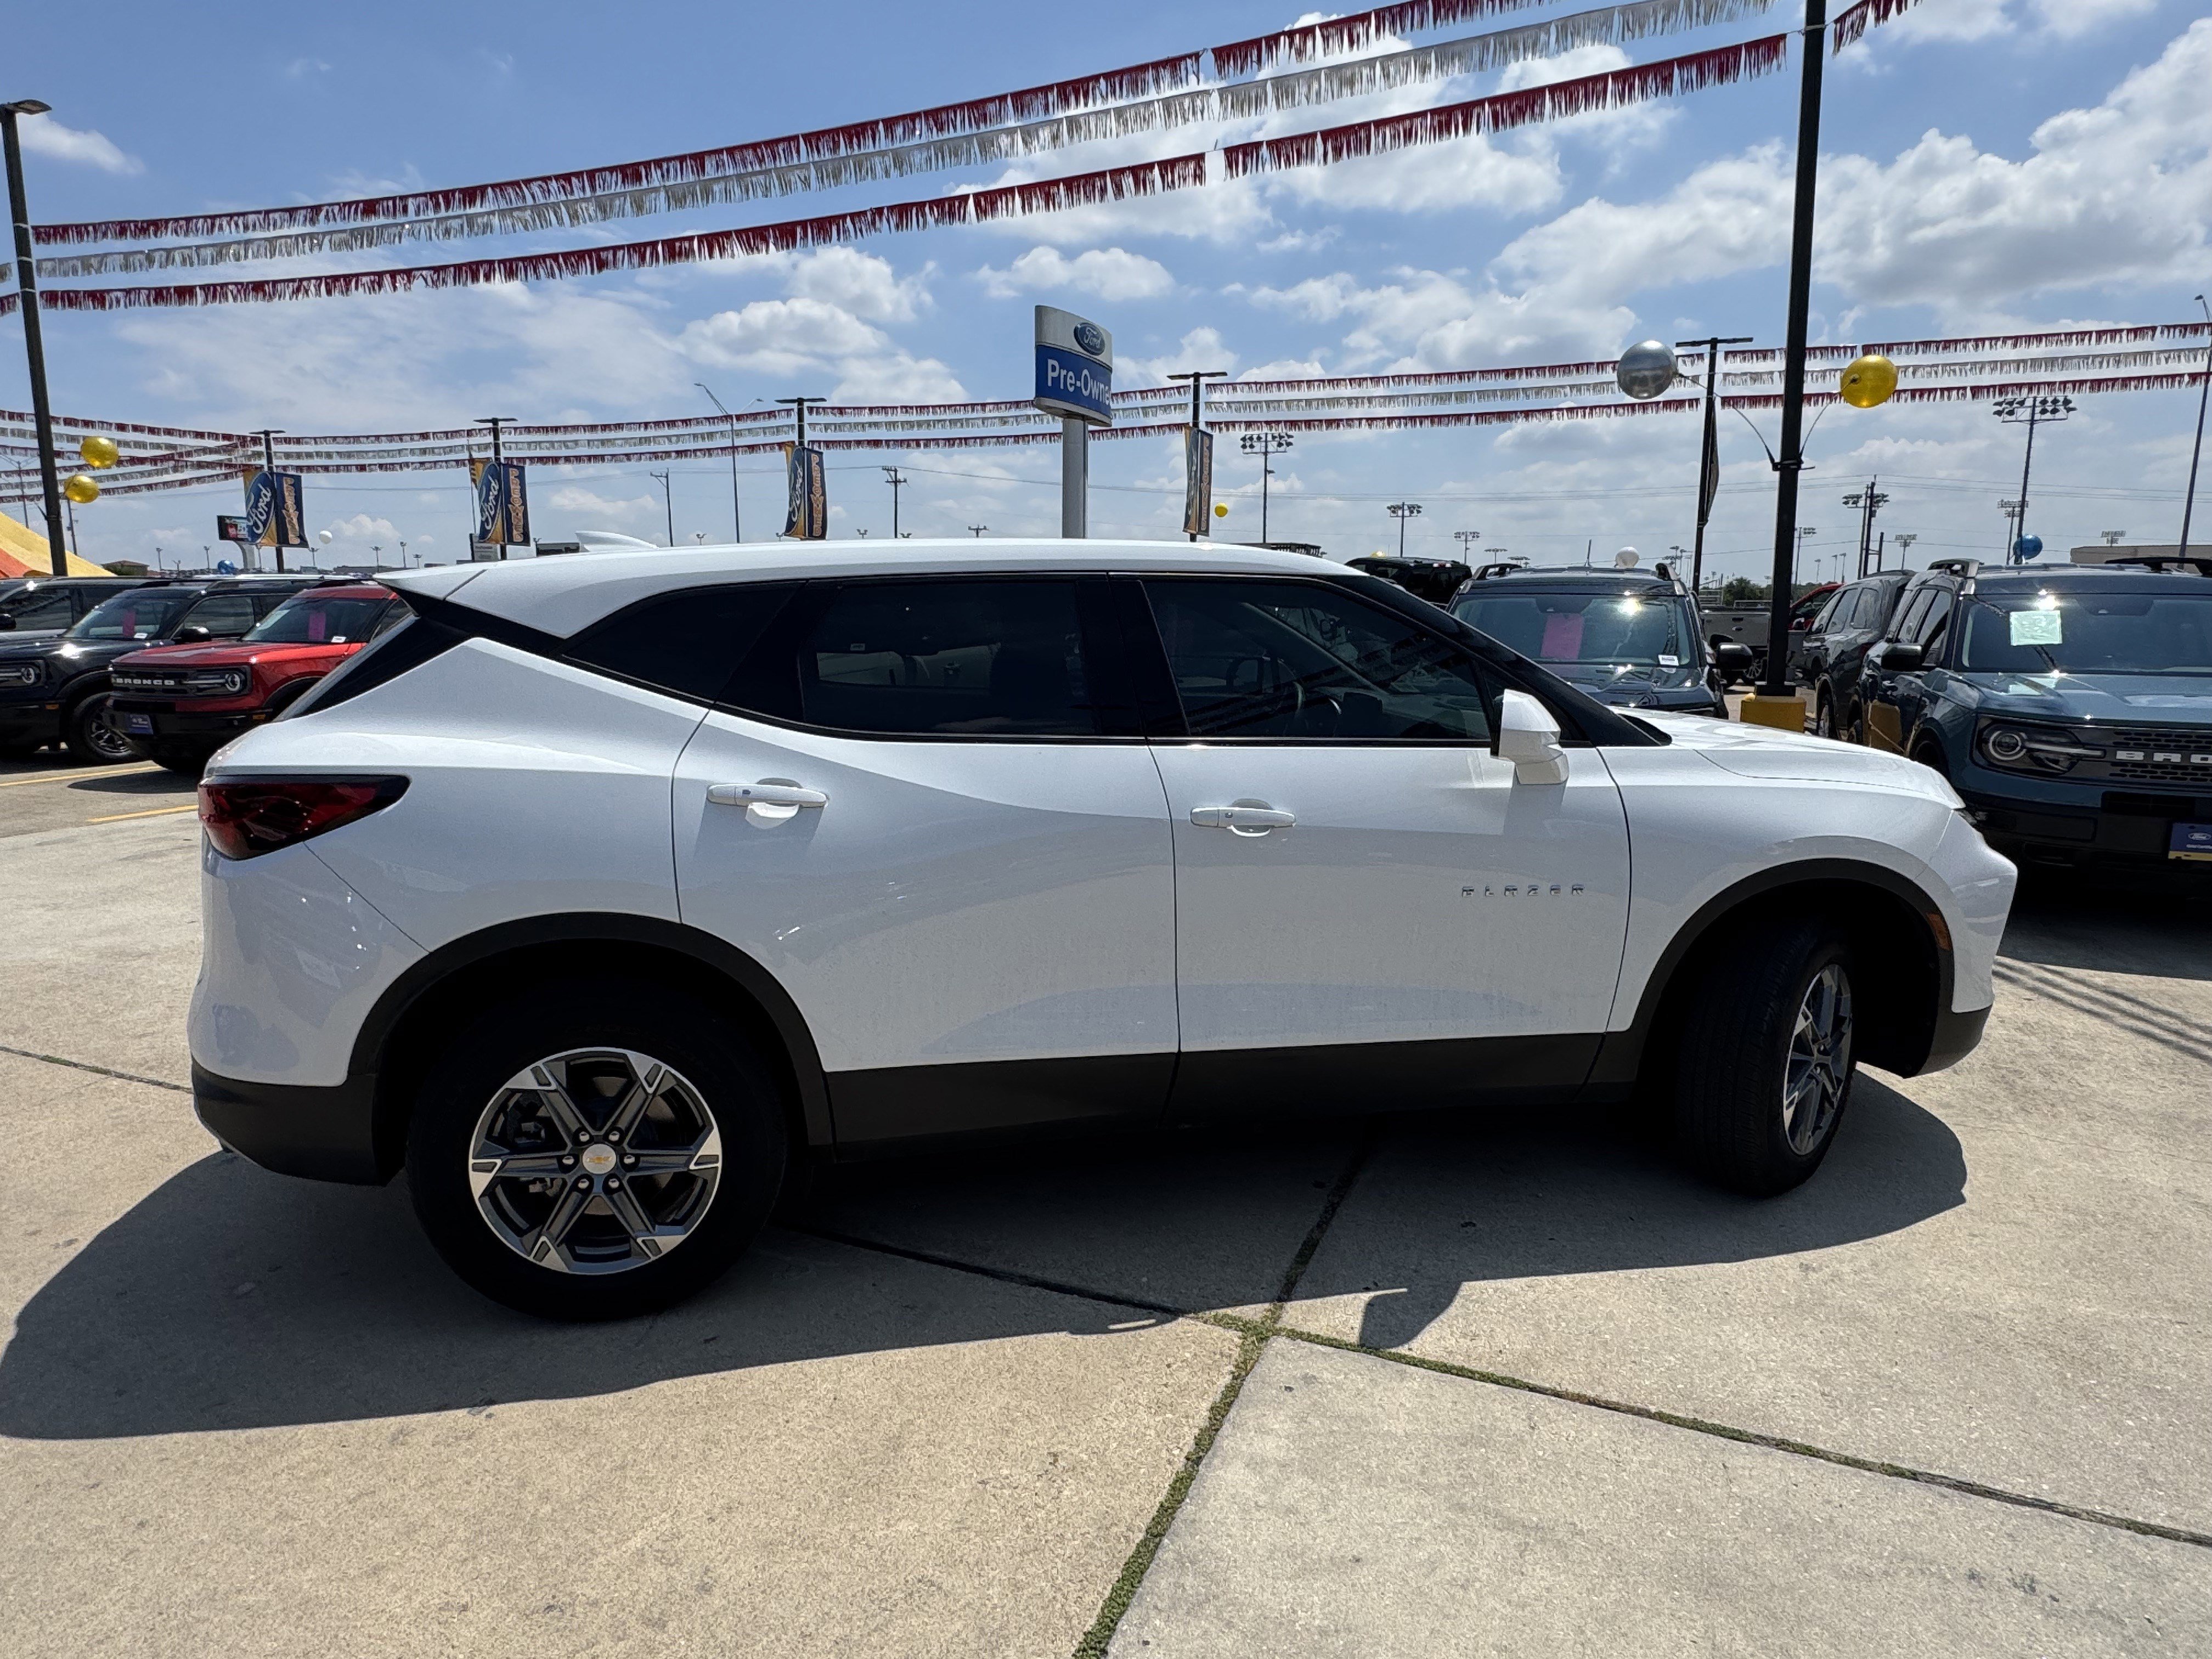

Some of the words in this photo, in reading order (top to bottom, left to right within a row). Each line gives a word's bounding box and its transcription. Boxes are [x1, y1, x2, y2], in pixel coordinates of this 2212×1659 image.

[1083, 327, 1101, 348] Ford
[1047, 358, 1111, 406] Pre-Owne
[246, 483, 272, 534] Ford
[479, 474, 500, 531] Ford
[116, 678, 175, 686] BRONCO
[1461, 884, 1585, 898] BLAZER
